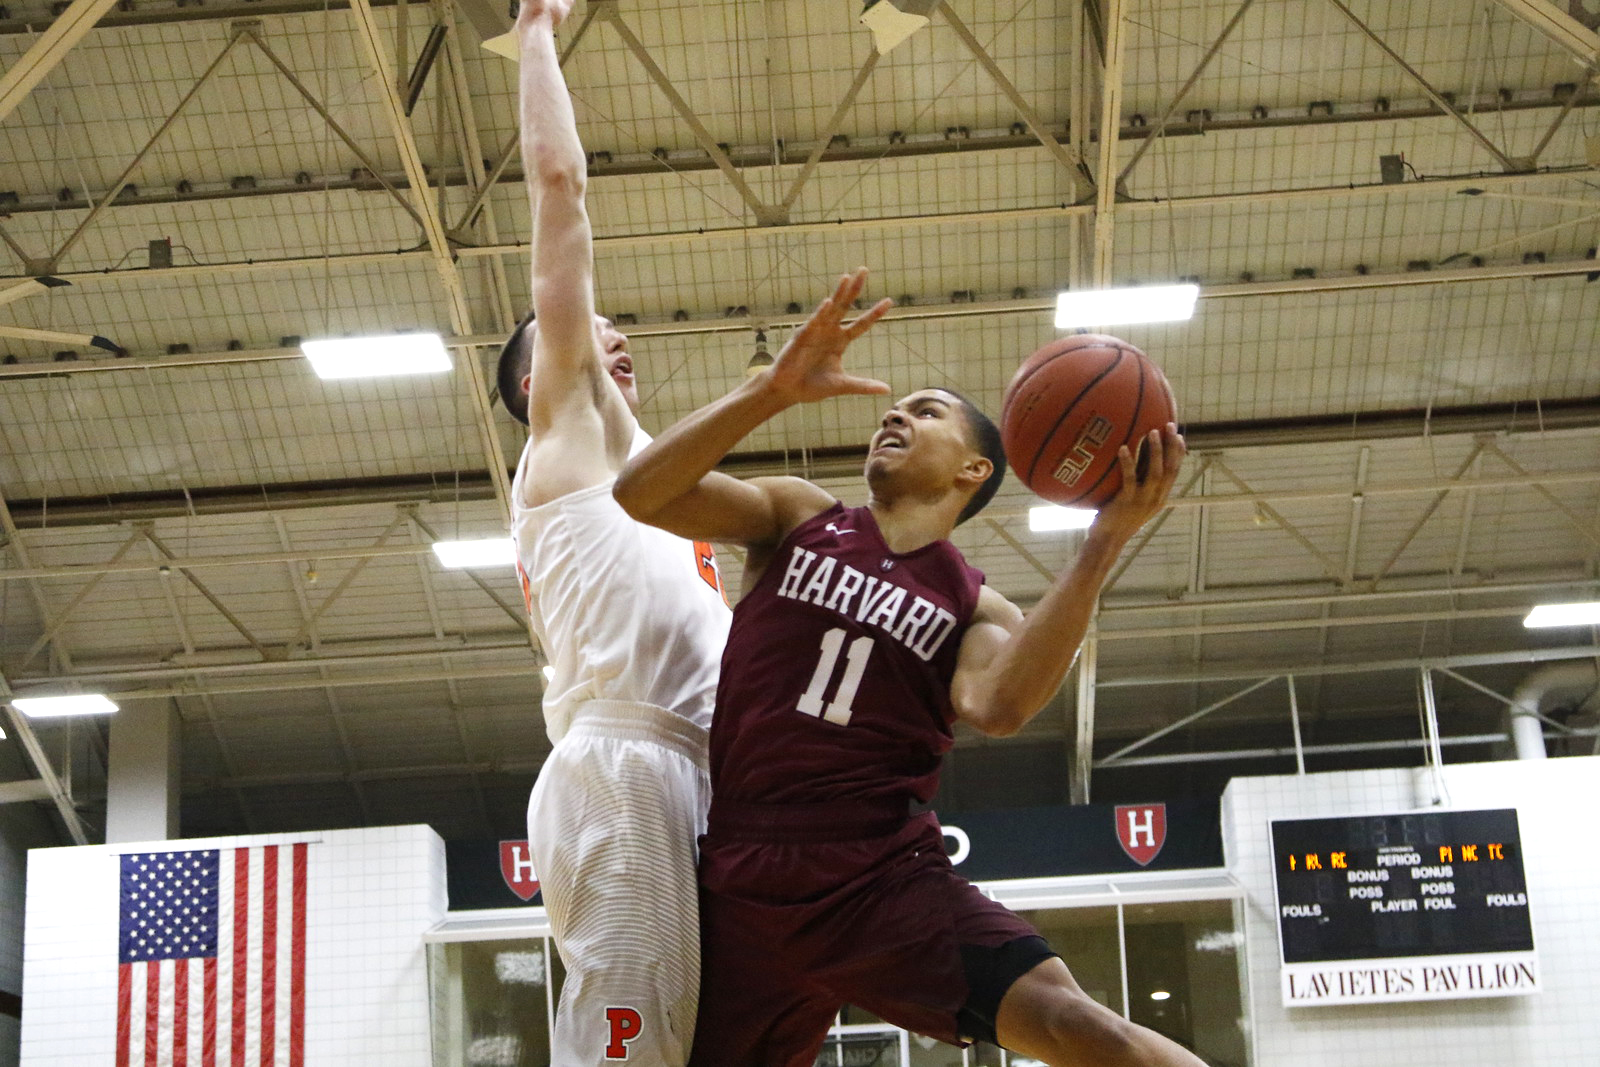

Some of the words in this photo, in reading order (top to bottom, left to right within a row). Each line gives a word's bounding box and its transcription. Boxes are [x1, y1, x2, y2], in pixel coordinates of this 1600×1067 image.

[882, 559, 894, 569] H
[777, 546, 957, 662] HARVARD
[796, 627, 875, 727] 11
[1127, 810, 1156, 847] H
[1377, 853, 1421, 866] PERIOD
[1347, 870, 1389, 882] BONUS
[1411, 866, 1453, 879] BONUS
[1350, 886, 1383, 899] POSS
[1421, 882, 1455, 895] POSS
[1371, 899, 1418, 912] PLAYER
[1424, 898, 1456, 910] FOUL
[1486, 893, 1527, 907] FOULS
[1282, 904, 1321, 917] FOULS
[1289, 968, 1414, 999] LAVIETES
[1422, 961, 1537, 992] PAVILION
[604, 1005, 644, 1060] P
